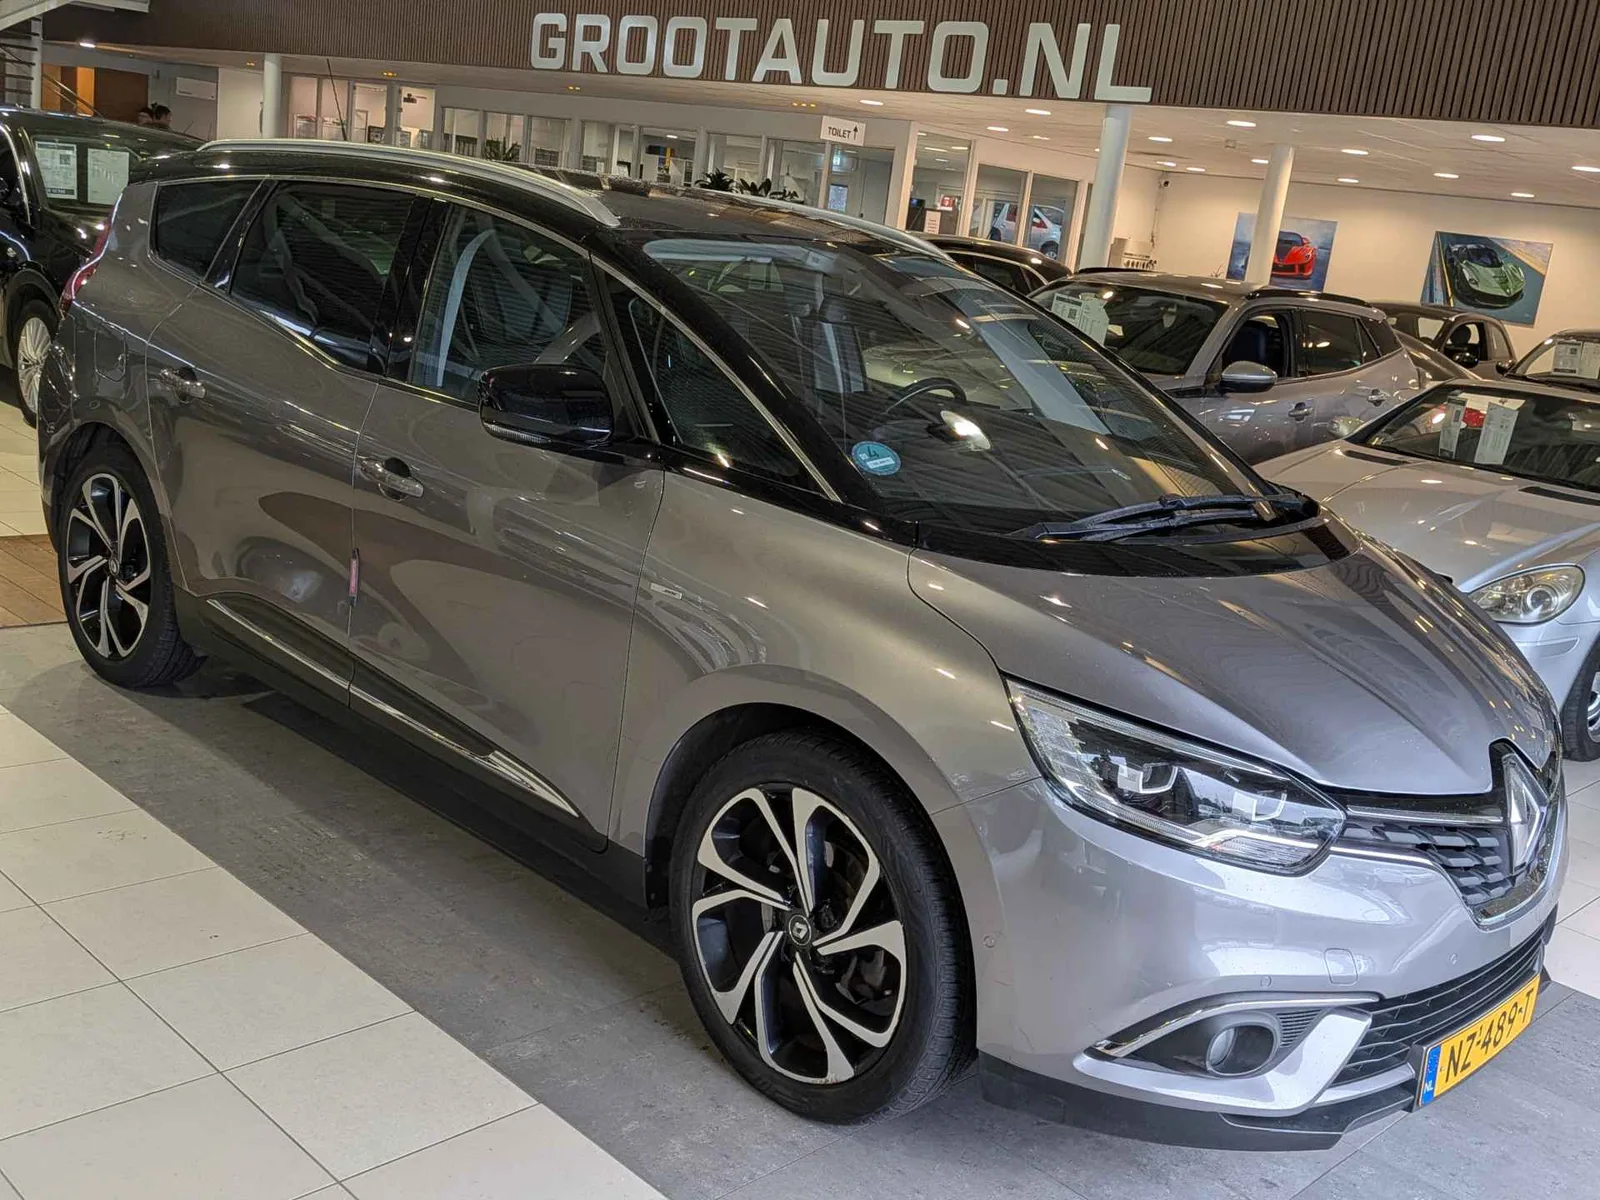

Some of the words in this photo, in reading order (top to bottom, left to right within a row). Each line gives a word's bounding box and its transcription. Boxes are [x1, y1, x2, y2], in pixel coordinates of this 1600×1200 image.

[531, 13, 1152, 103] GROOTAUTO.NL
[828, 126, 851, 139] TOILET
[1445, 988, 1534, 1083] NZ-489-T
[1424, 1080, 1434, 1094] NL
